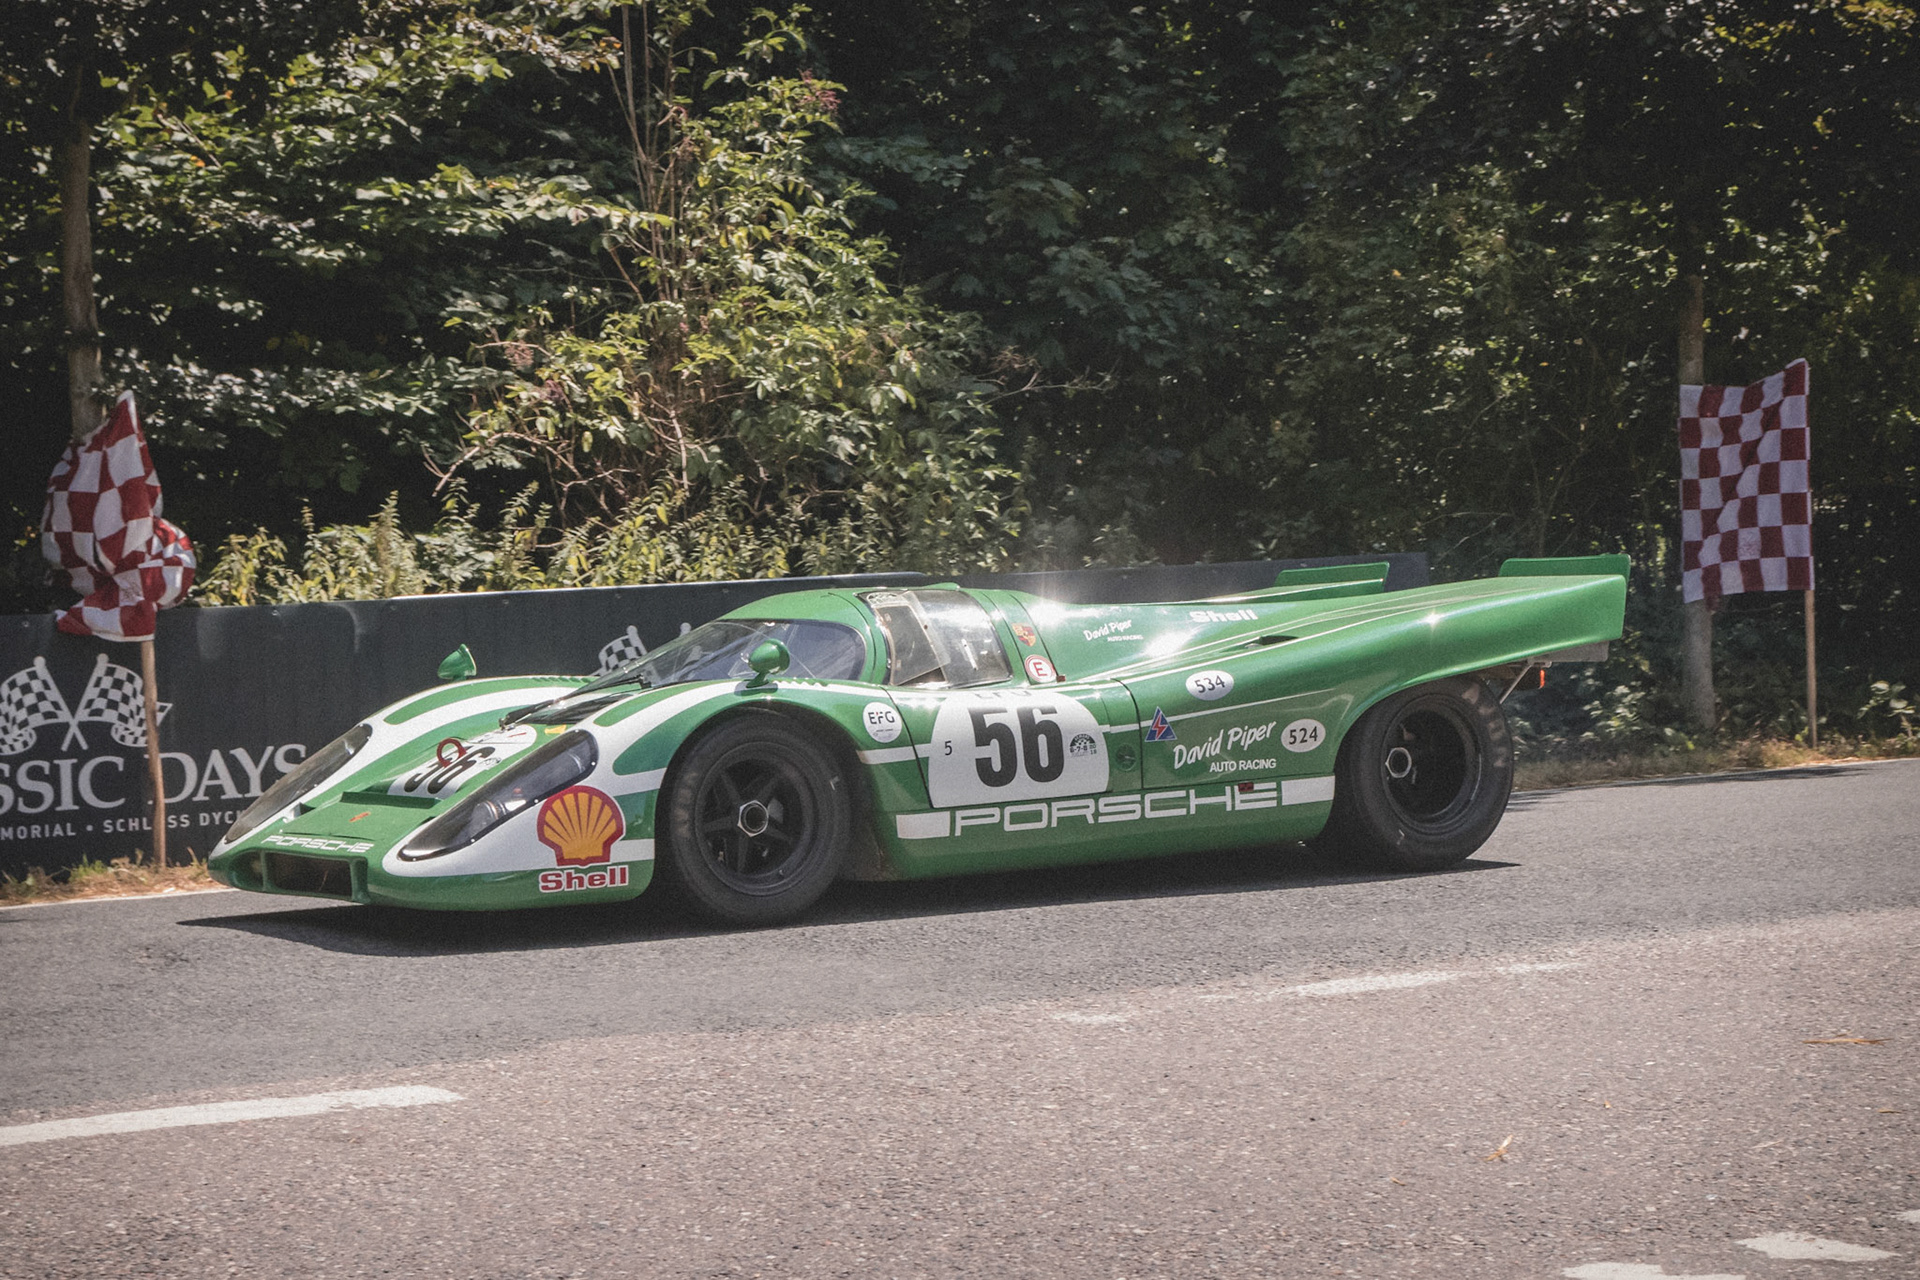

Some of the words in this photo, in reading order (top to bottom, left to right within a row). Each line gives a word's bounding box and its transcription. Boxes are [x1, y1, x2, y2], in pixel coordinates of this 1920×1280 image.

[1189, 609, 1258, 622] Shell
[1083, 623, 1110, 641] David
[1108, 619, 1132, 632] Piper
[1033, 662, 1047, 676] E
[1195, 675, 1225, 693] 534
[1173, 729, 1224, 769] David
[1227, 721, 1277, 750] Piper
[1289, 726, 1318, 745] 524
[944, 741, 953, 756] 5
[967, 705, 1064, 787] 56
[1209, 760, 1238, 773] AUTO
[1239, 758, 1277, 771] RACING
[955, 782, 1278, 836] PORSCHE
[103, 814, 190, 833] SCHLSS
[261, 835, 375, 853] PORSCHE
[539, 865, 628, 892] Shell
